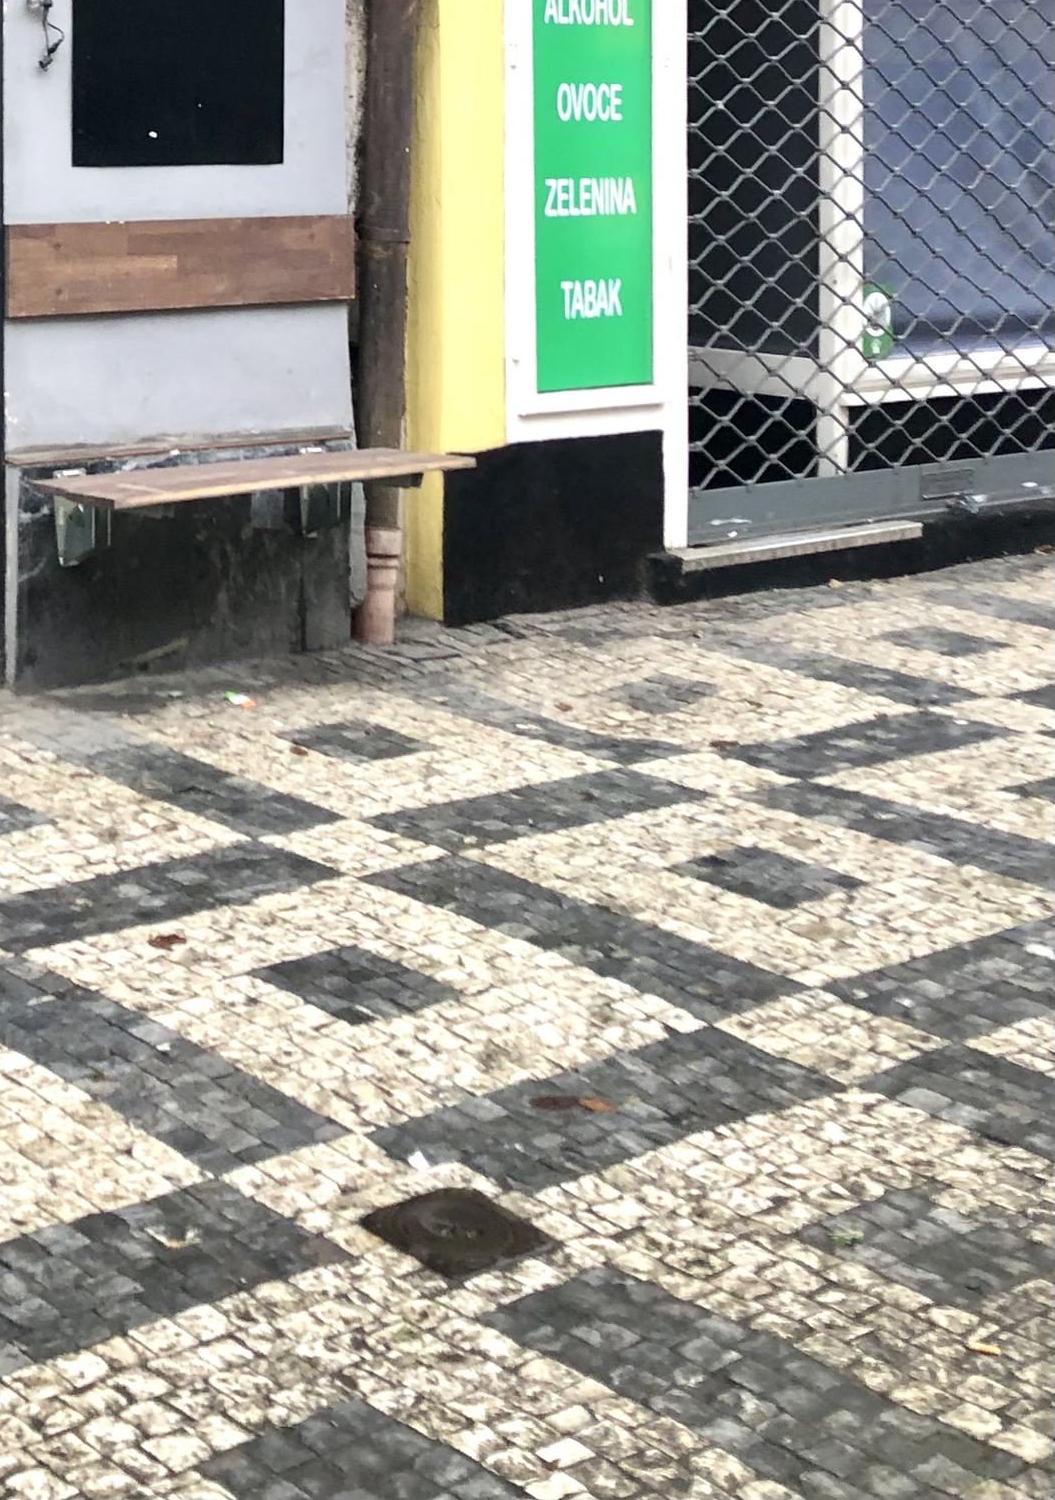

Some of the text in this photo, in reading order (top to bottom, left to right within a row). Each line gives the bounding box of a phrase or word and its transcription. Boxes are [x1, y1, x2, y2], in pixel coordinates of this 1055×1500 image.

[557, 82, 623, 122] OVOCE
[544, 177, 637, 217] ZELENINA
[561, 278, 622, 321] TABAK
